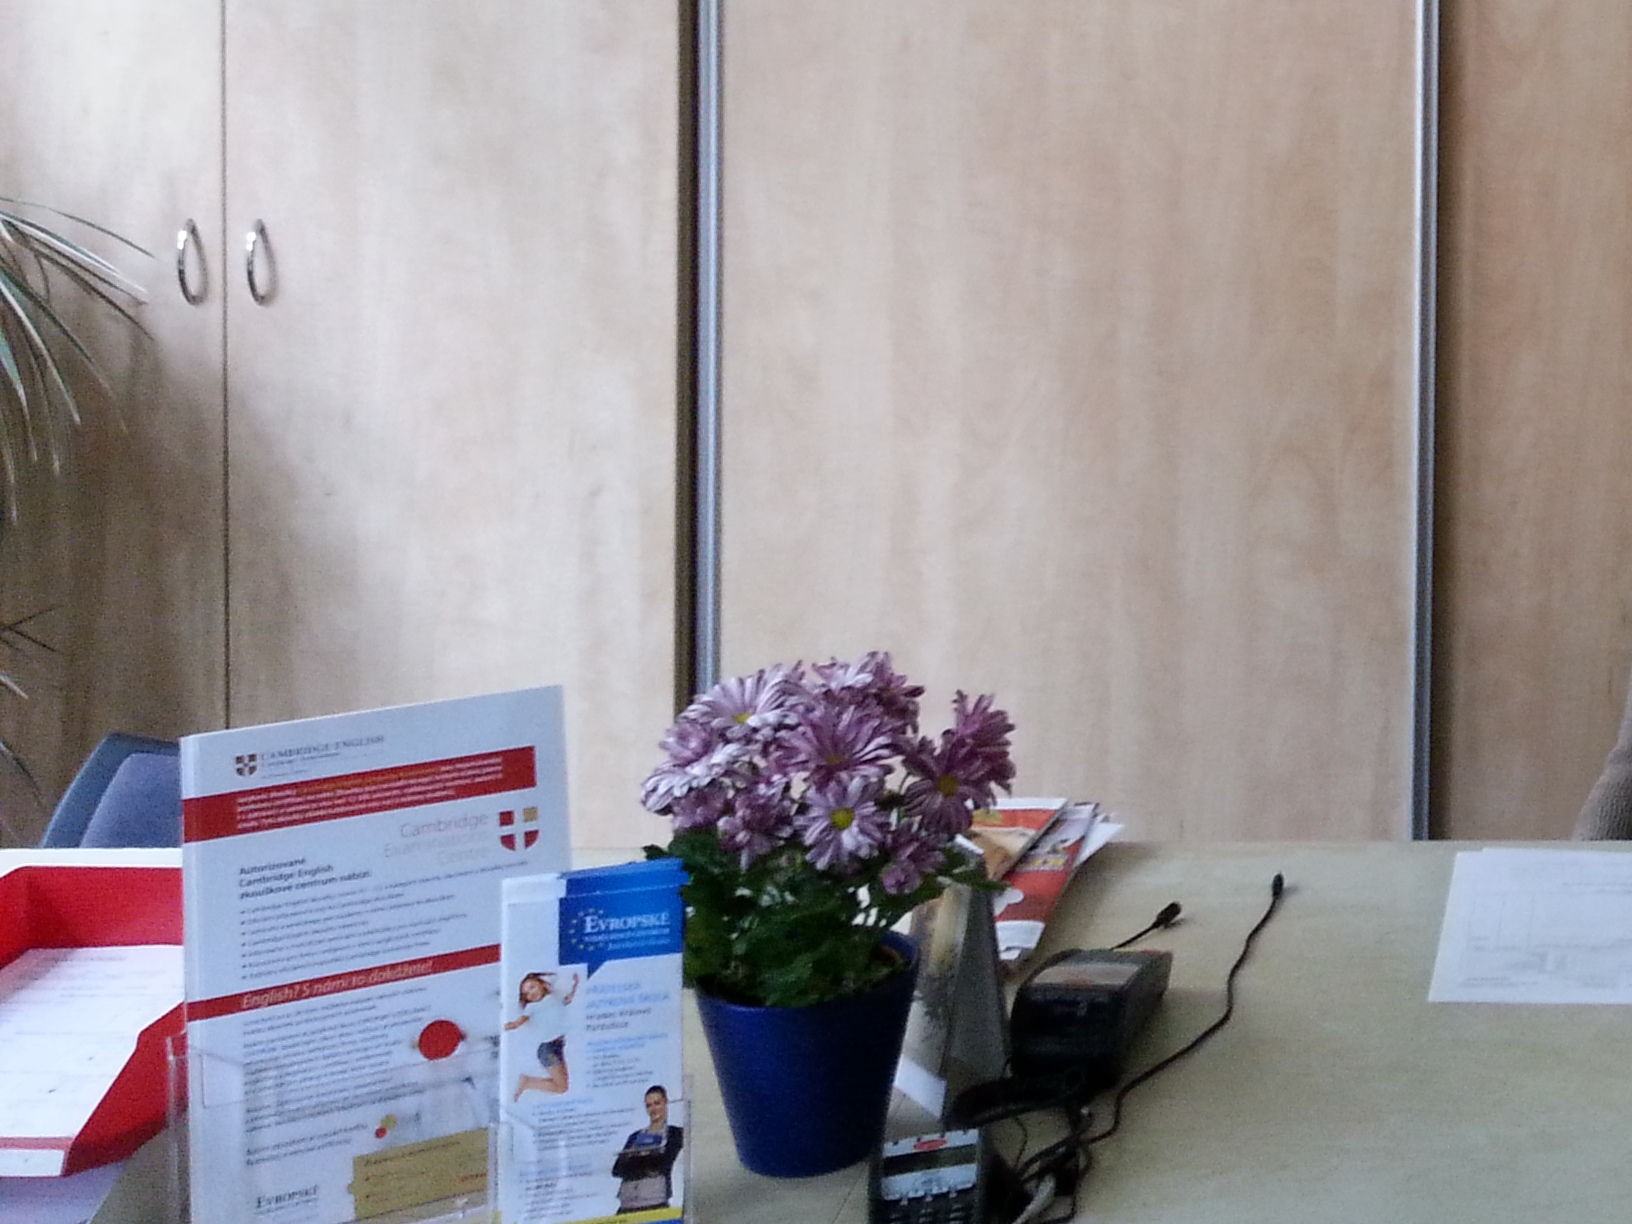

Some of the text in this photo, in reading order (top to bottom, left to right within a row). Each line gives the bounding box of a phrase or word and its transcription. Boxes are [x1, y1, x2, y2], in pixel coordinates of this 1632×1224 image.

[399, 813, 490, 839] Cambridge
[239, 864, 334, 889] Cambridge English
[295, 876, 338, 892] centrum
[240, 986, 300, 1010] English?
